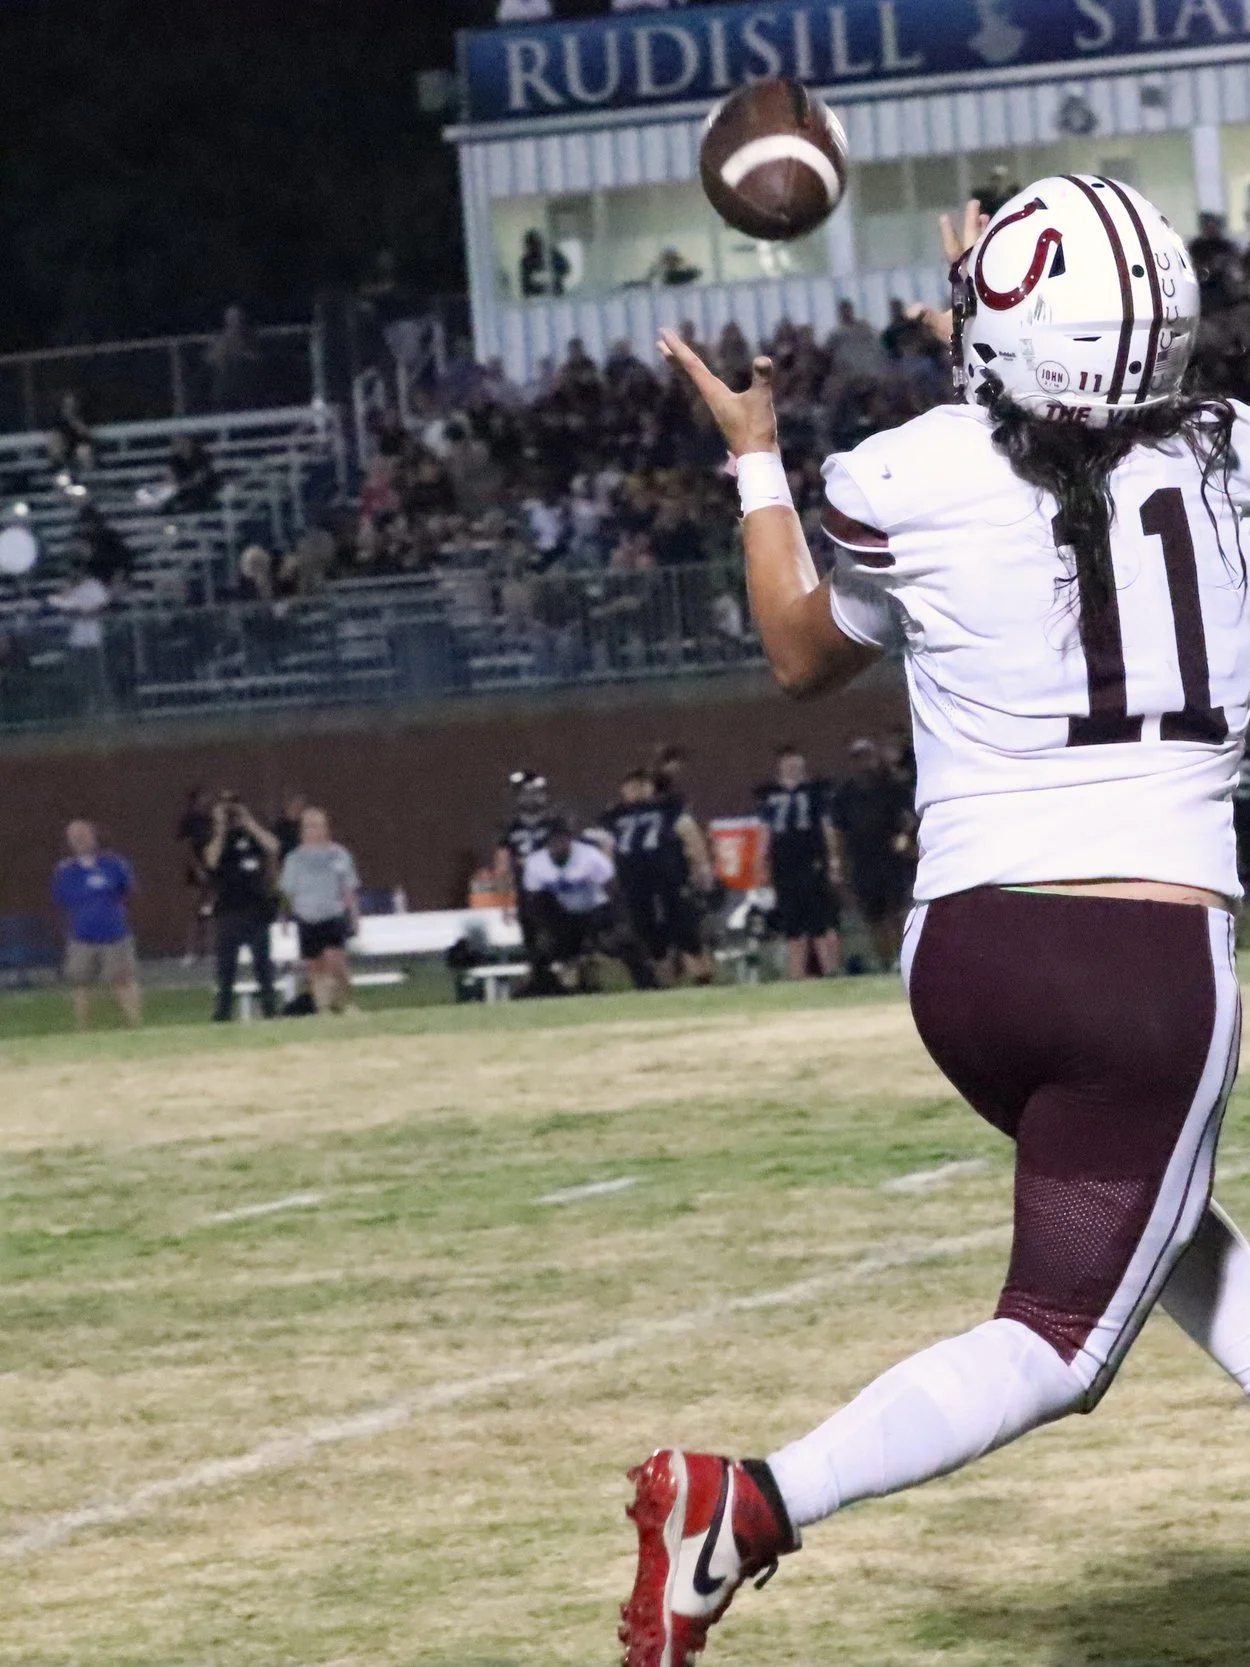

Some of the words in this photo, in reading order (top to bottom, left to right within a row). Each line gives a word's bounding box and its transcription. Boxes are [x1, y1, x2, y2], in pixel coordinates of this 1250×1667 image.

[505, 0, 925, 110] RUDISILL
[1041, 369, 1063, 383] JOHN
[1079, 371, 1103, 393] 11
[1052, 487, 1228, 747] 11
[615, 811, 663, 853] 77
